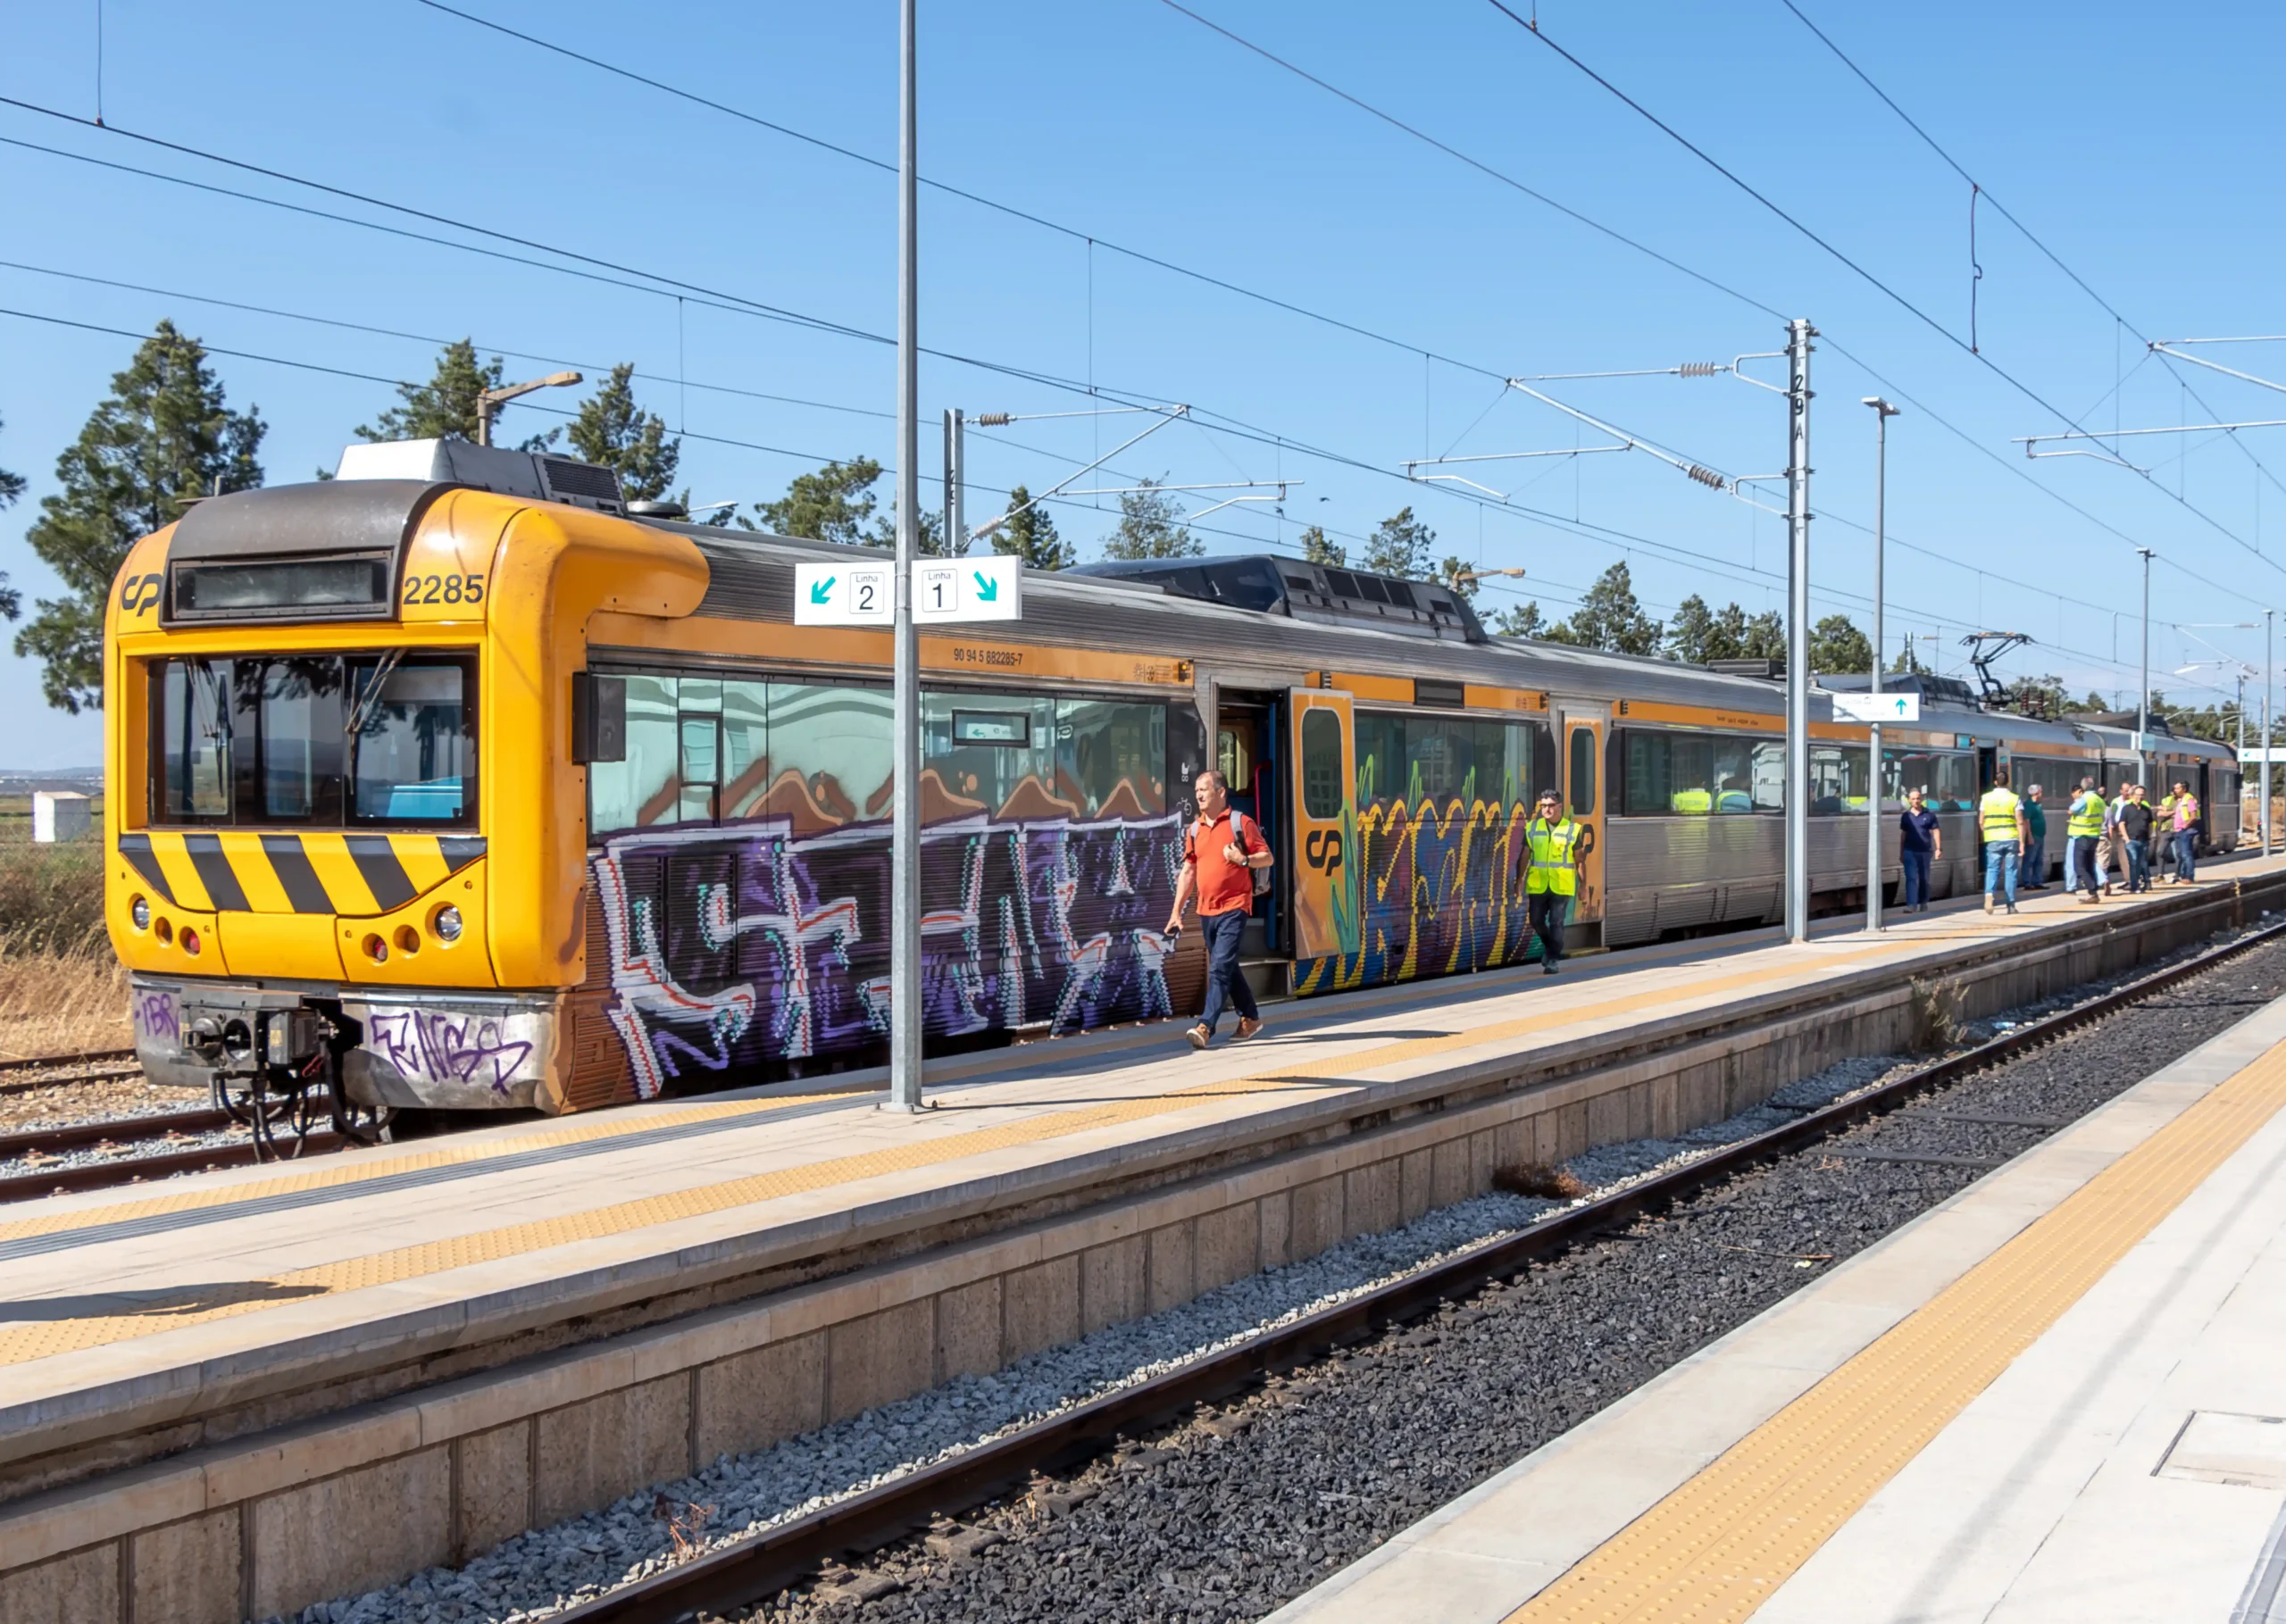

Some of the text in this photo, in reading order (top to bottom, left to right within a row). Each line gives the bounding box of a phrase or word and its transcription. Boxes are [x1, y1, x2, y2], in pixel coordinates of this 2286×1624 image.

[855, 575, 878, 583] Linha
[928, 572, 951, 580] Linha
[404, 574, 484, 604] 2285
[859, 585, 873, 610] 2
[932, 583, 942, 608] 1
[954, 648, 1022, 666] 90 94 5 882285-7
